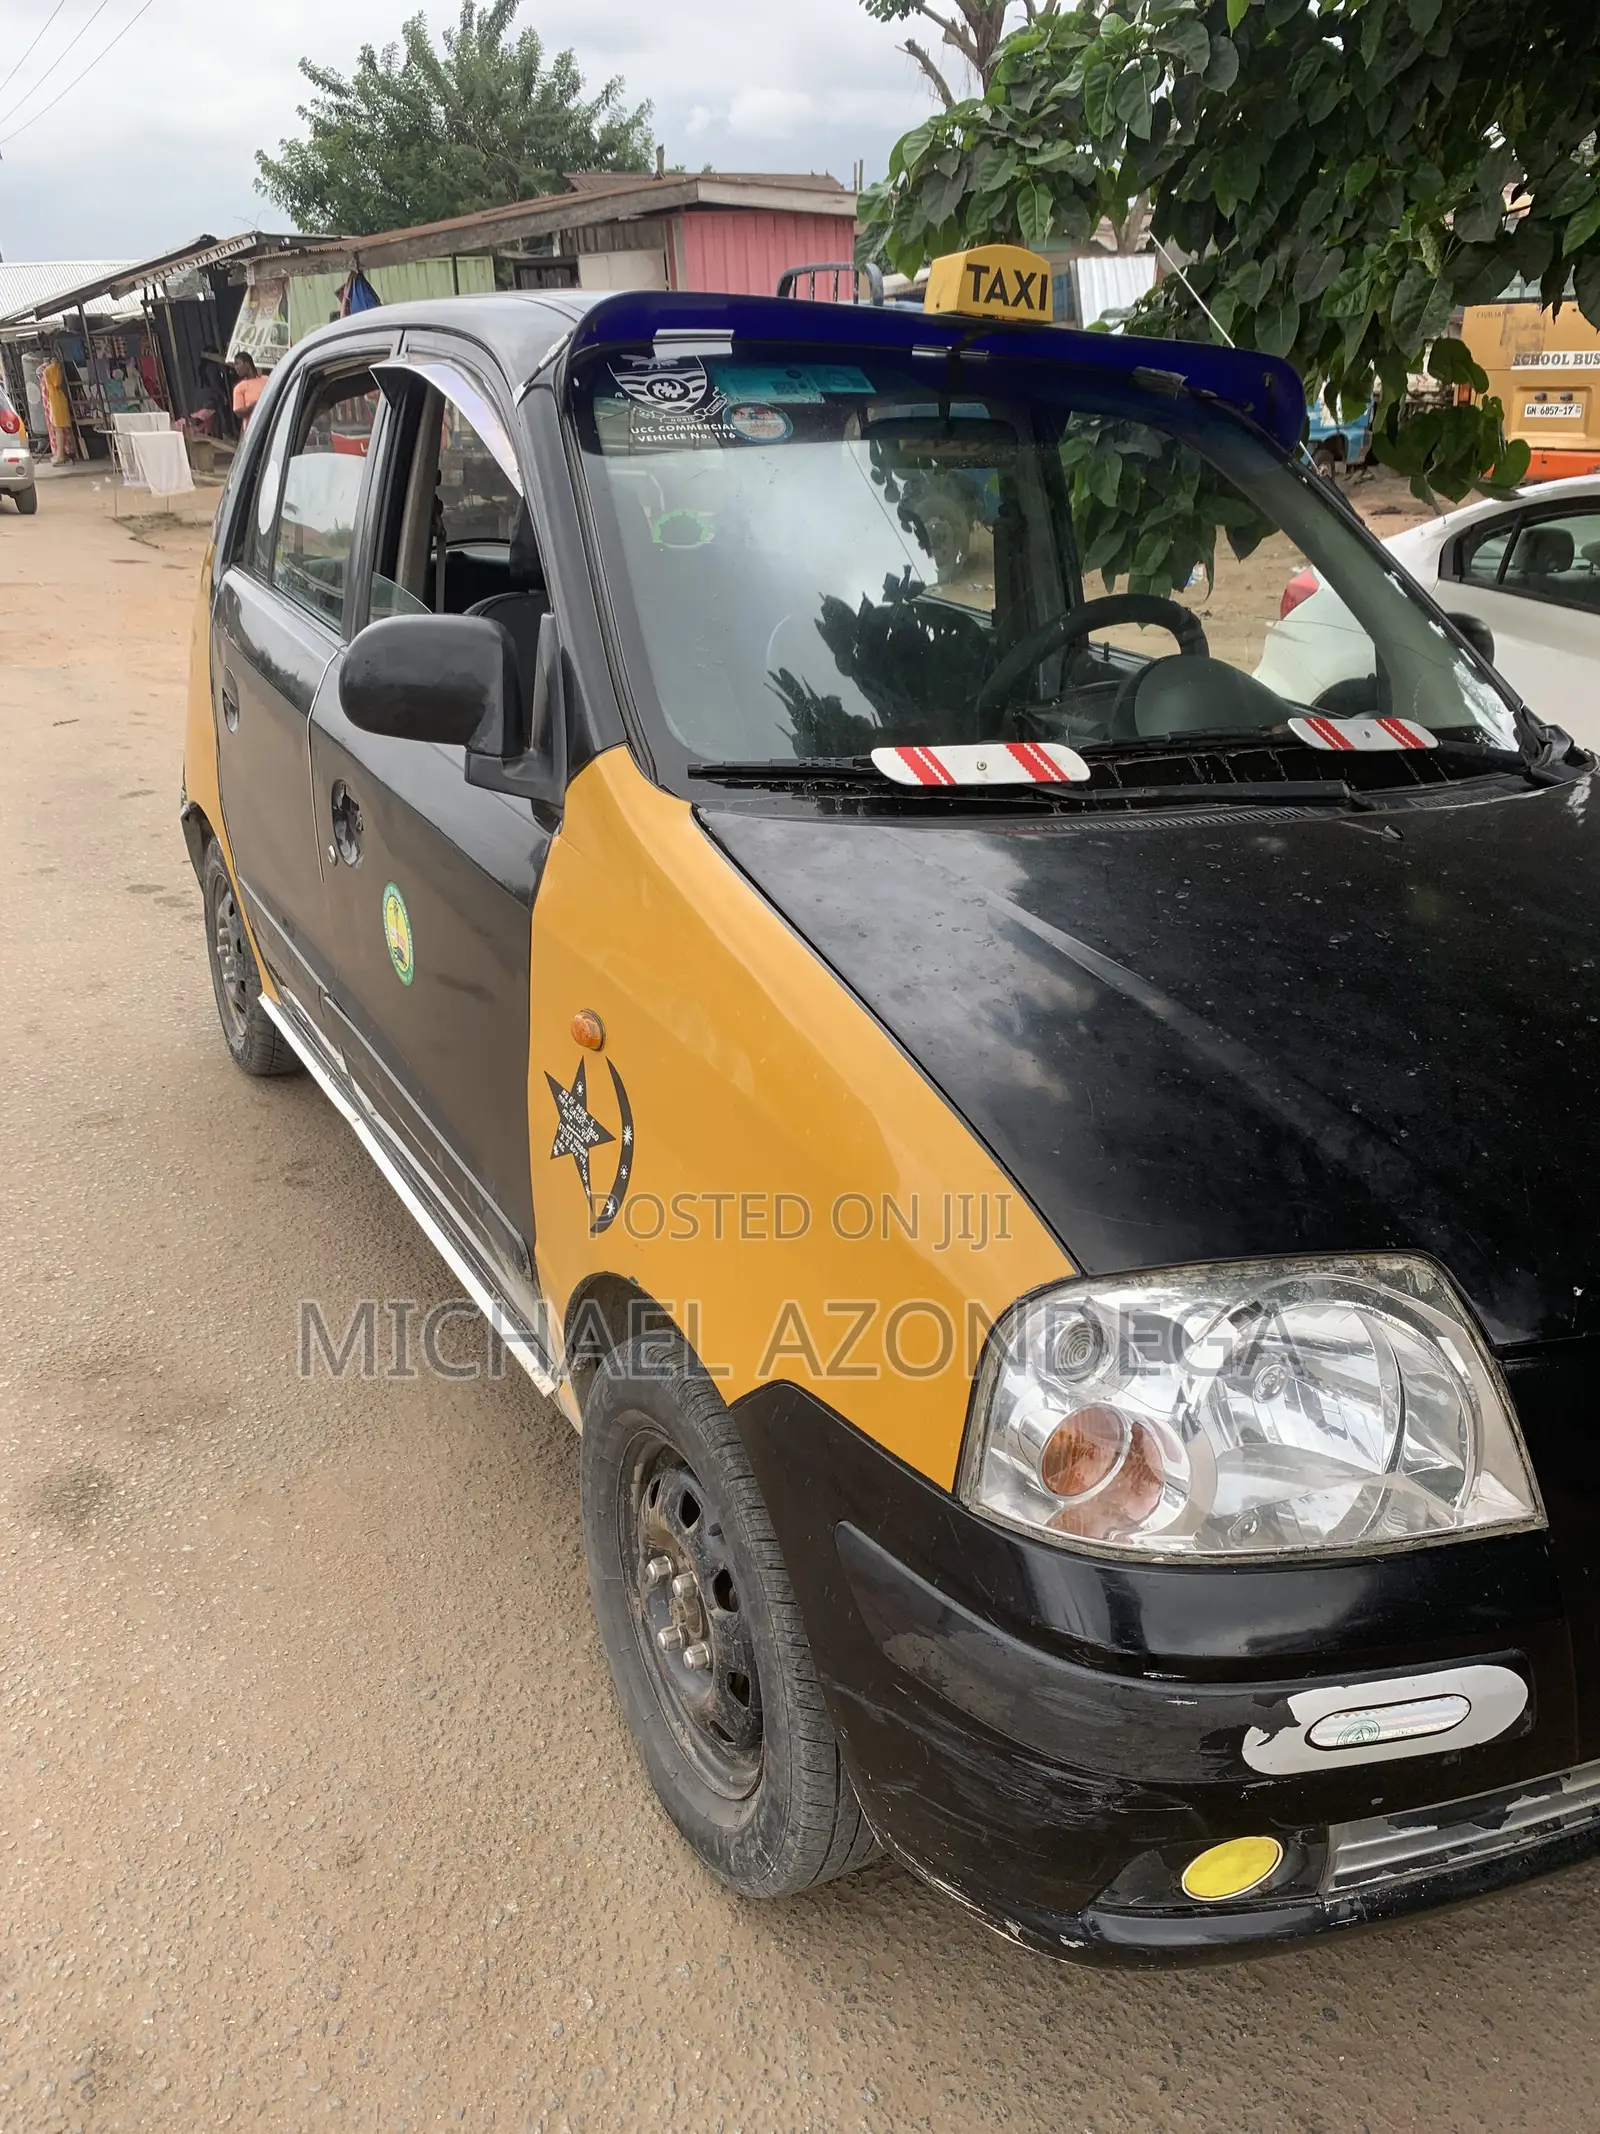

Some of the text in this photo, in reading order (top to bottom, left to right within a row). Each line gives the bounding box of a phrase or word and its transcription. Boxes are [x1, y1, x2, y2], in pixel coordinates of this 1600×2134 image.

[215, 240, 245, 258] IRON
[966, 263, 1048, 311] TAXI
[1512, 353, 1570, 367] SCHOOL
[1526, 405, 1537, 415] GN
[630, 423, 737, 434] UCC COMMERCIAL
[637, 432, 687, 442] VEHICLE
[690, 432, 711, 440] No.
